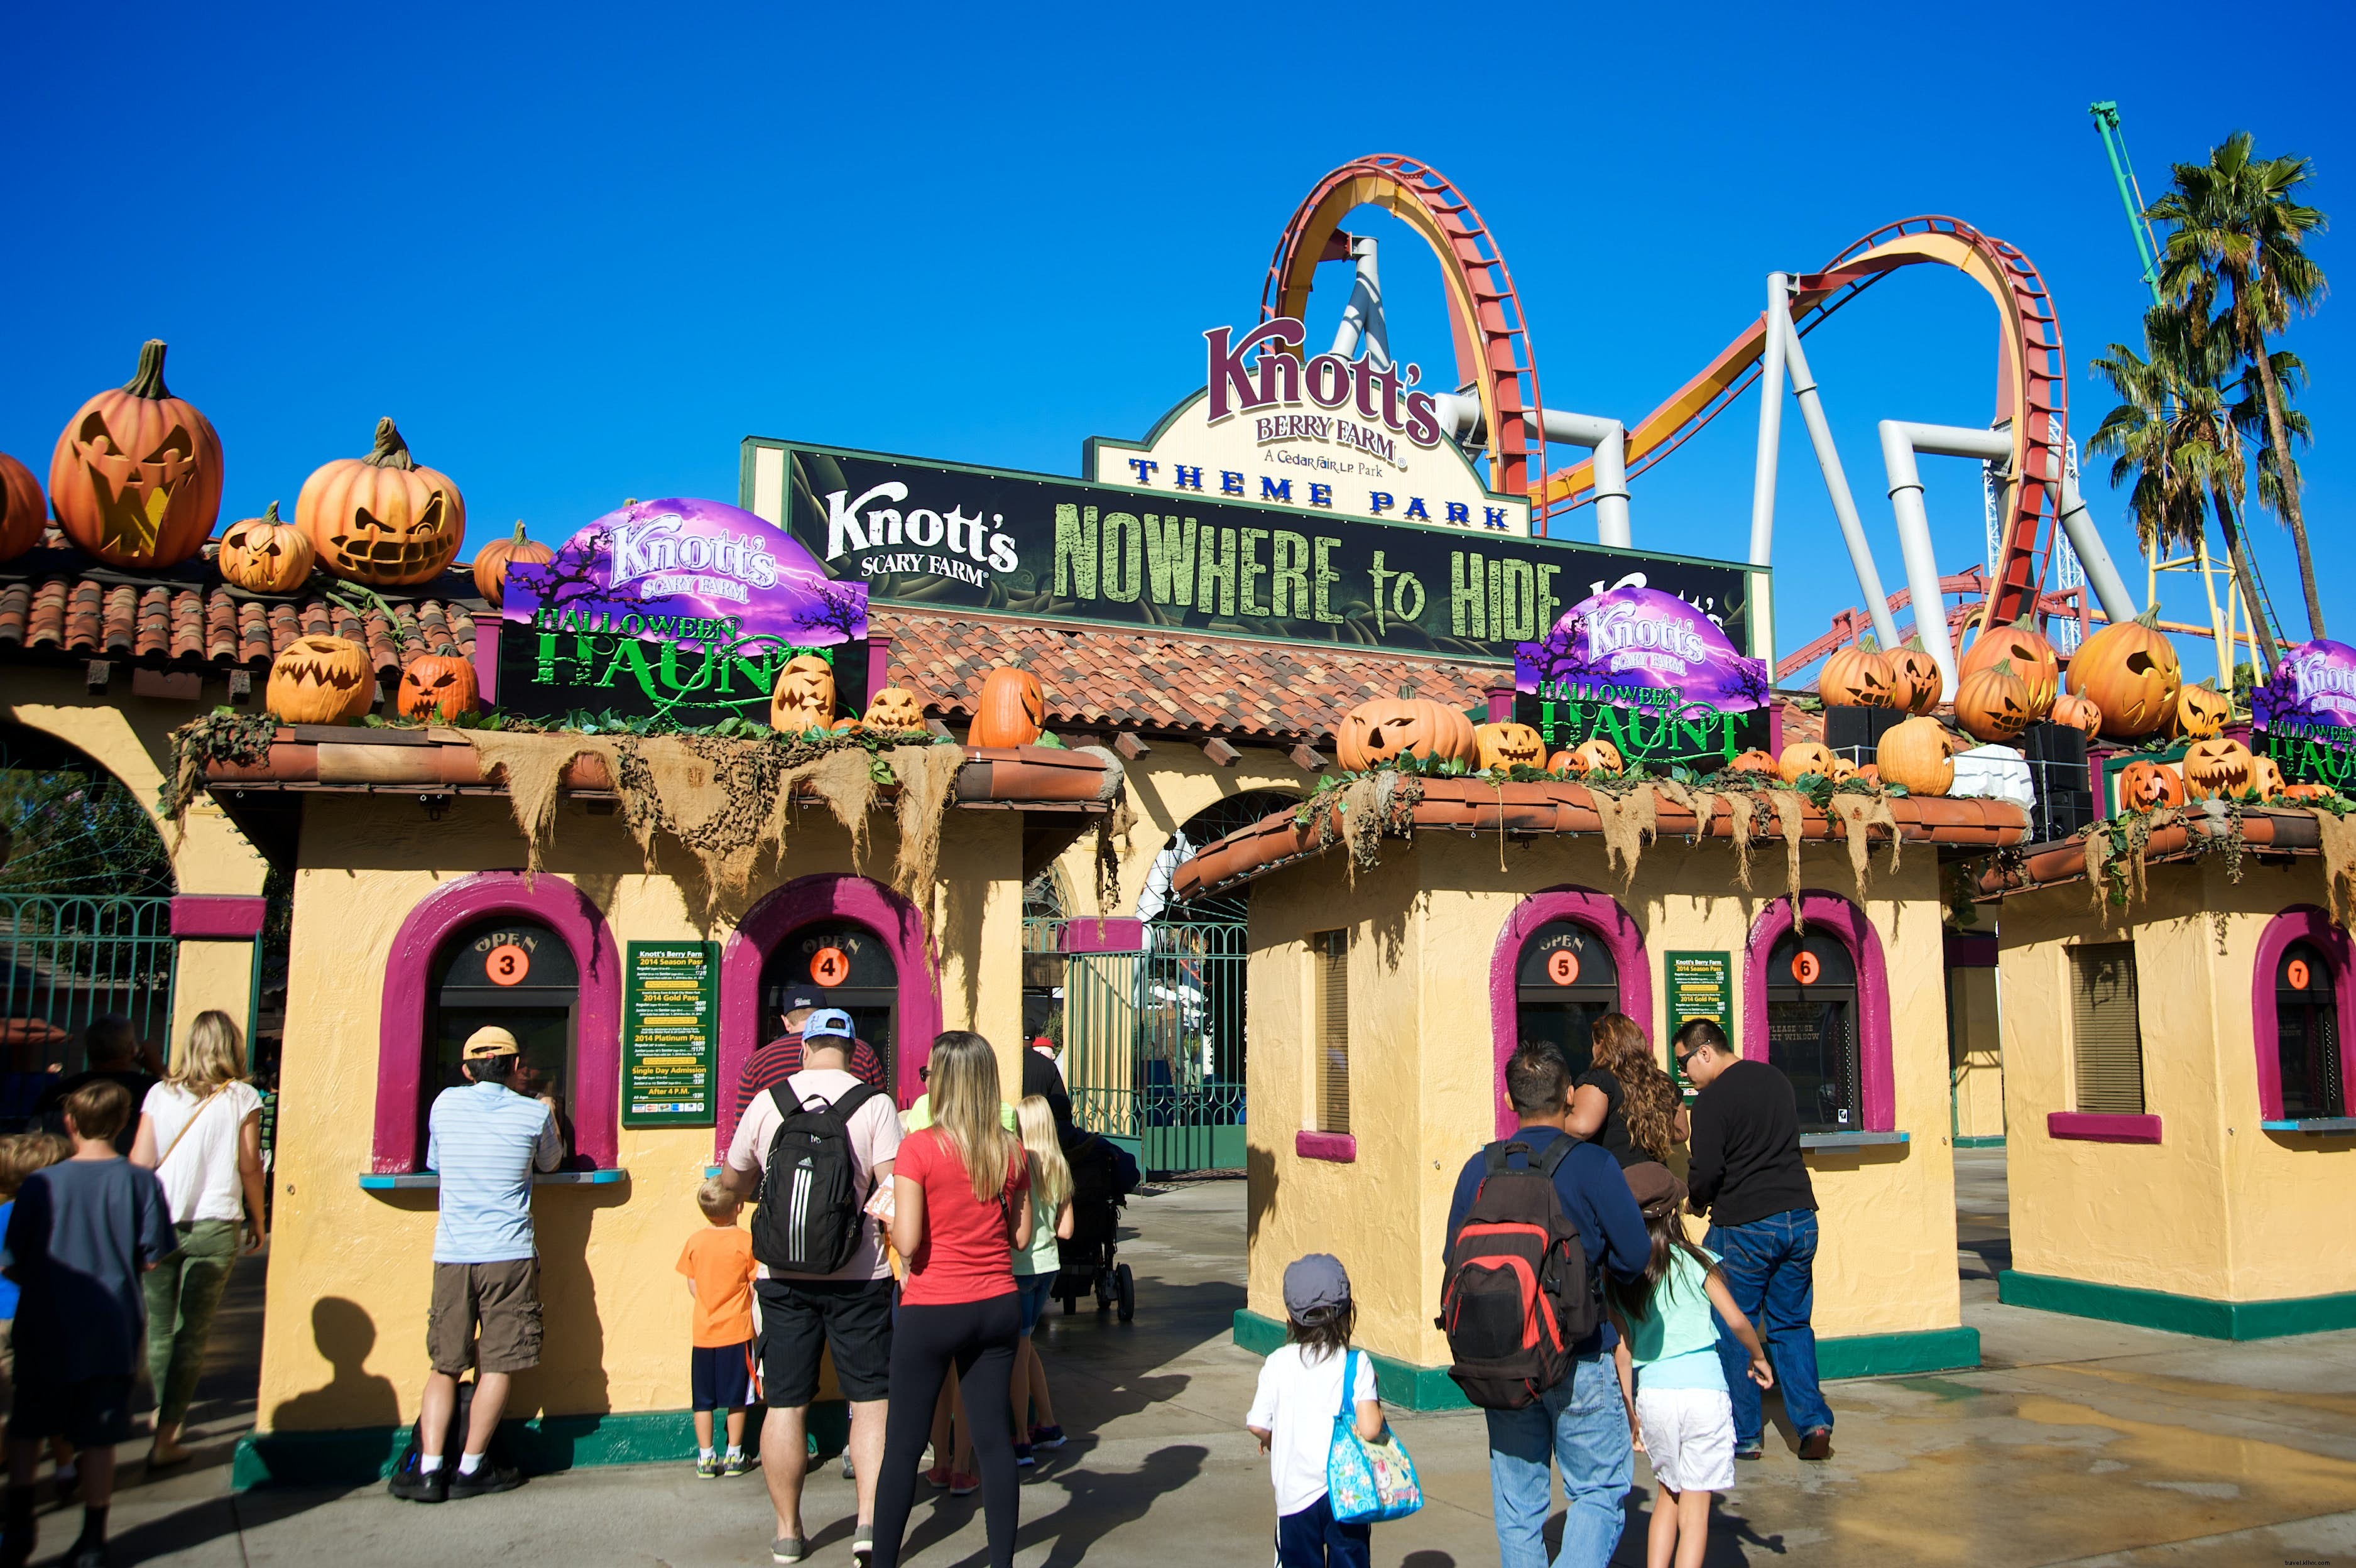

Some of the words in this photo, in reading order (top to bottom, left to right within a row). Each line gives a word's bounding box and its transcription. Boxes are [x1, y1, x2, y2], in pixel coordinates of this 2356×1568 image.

[1204, 318, 1442, 445] Knott's
[1257, 416, 1331, 442] BERRY
[1337, 419, 1395, 462] FARM
[1265, 449, 1273, 462] A
[1358, 462, 1383, 477] Park
[1128, 457, 1332, 505] THEME
[1369, 491, 1508, 528] PARK
[825, 481, 1018, 572] Knott's
[610, 514, 777, 589] Knott's
[861, 553, 923, 577] SCARY
[929, 554, 984, 589] FARM
[1052, 503, 1344, 625] NOWHERE
[1367, 550, 1426, 637] to
[1451, 550, 1561, 643] HIDE
[641, 577, 694, 600] SCARY
[699, 576, 749, 604] FARM
[537, 607, 738, 641] HALLOWEEN
[1586, 602, 1706, 663] Knott's
[1611, 653, 1649, 672] SCARY
[1652, 653, 1687, 676] FARM
[1539, 680, 1681, 707] HALLOWEEN
[1539, 701, 1748, 766] HAUNT
[475, 932, 538, 953] OPEN
[802, 935, 861, 954] OPEN
[1540, 934, 1584, 952] OPEN
[499, 955, 515, 975] 3
[821, 957, 836, 976] 4
[1557, 959, 1569, 976] 5
[1801, 961, 1811, 976] 6
[2294, 968, 2302, 983] 7
